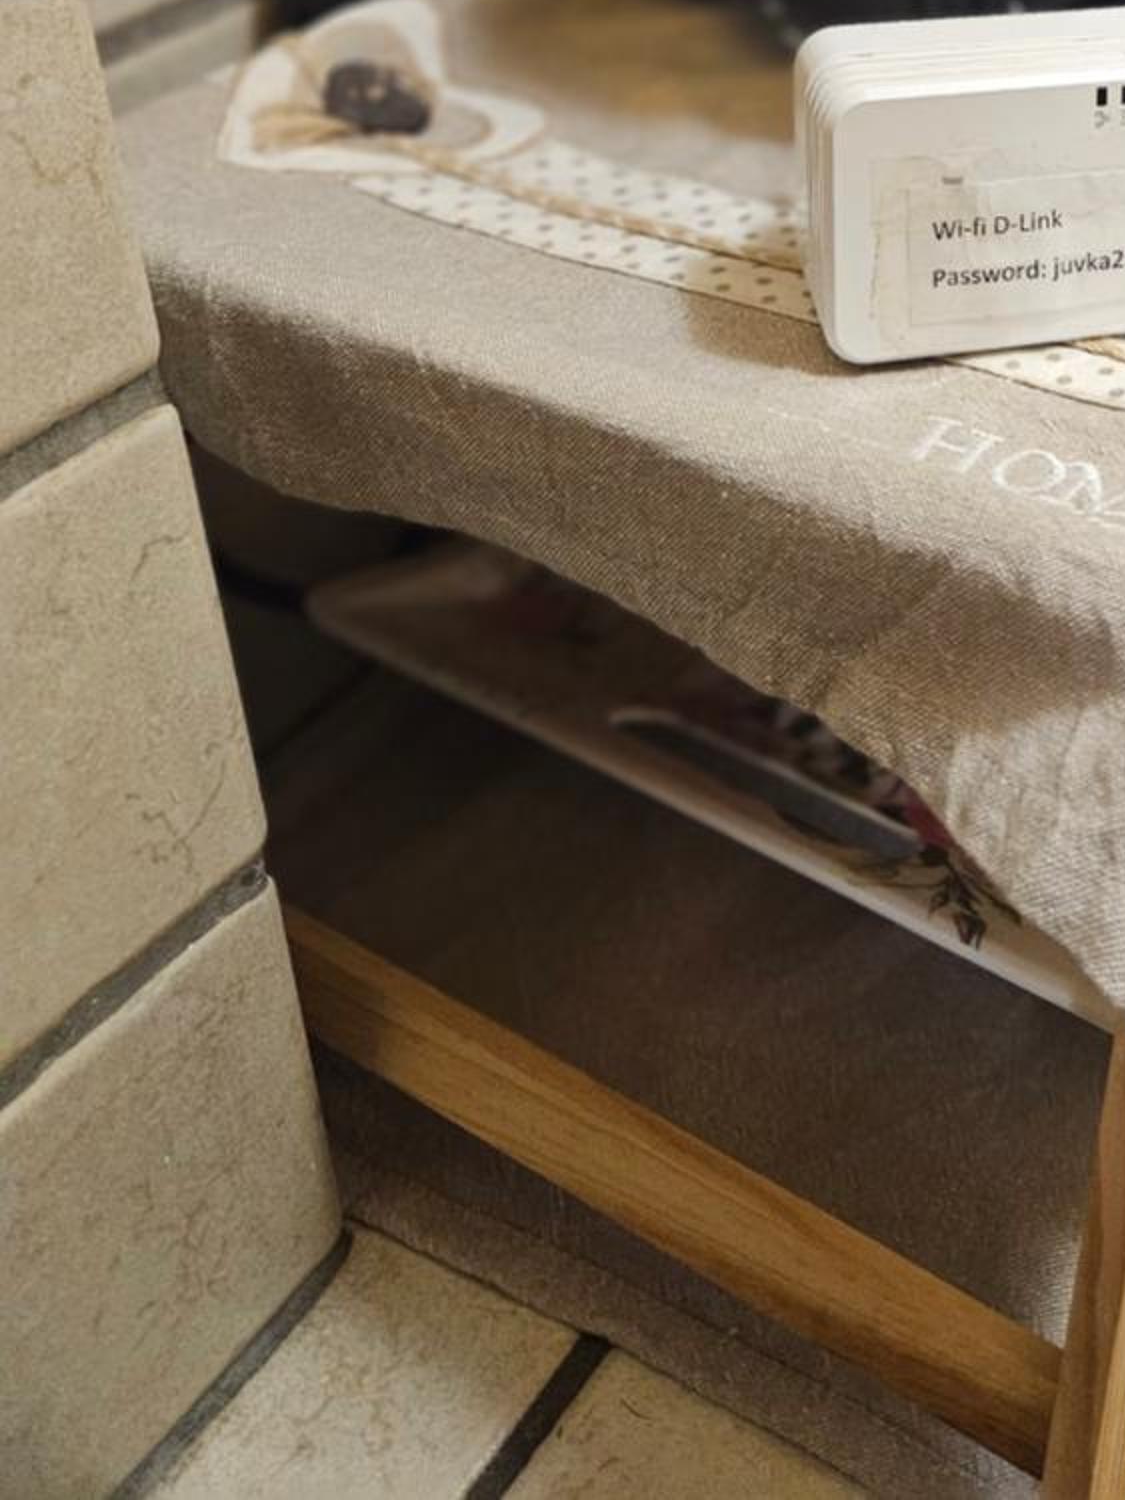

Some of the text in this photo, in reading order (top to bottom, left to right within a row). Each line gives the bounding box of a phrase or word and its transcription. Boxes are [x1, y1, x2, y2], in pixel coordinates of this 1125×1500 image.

[932, 209, 1063, 241] Wi-fi D-Link
[932, 260, 1047, 288] Password:
